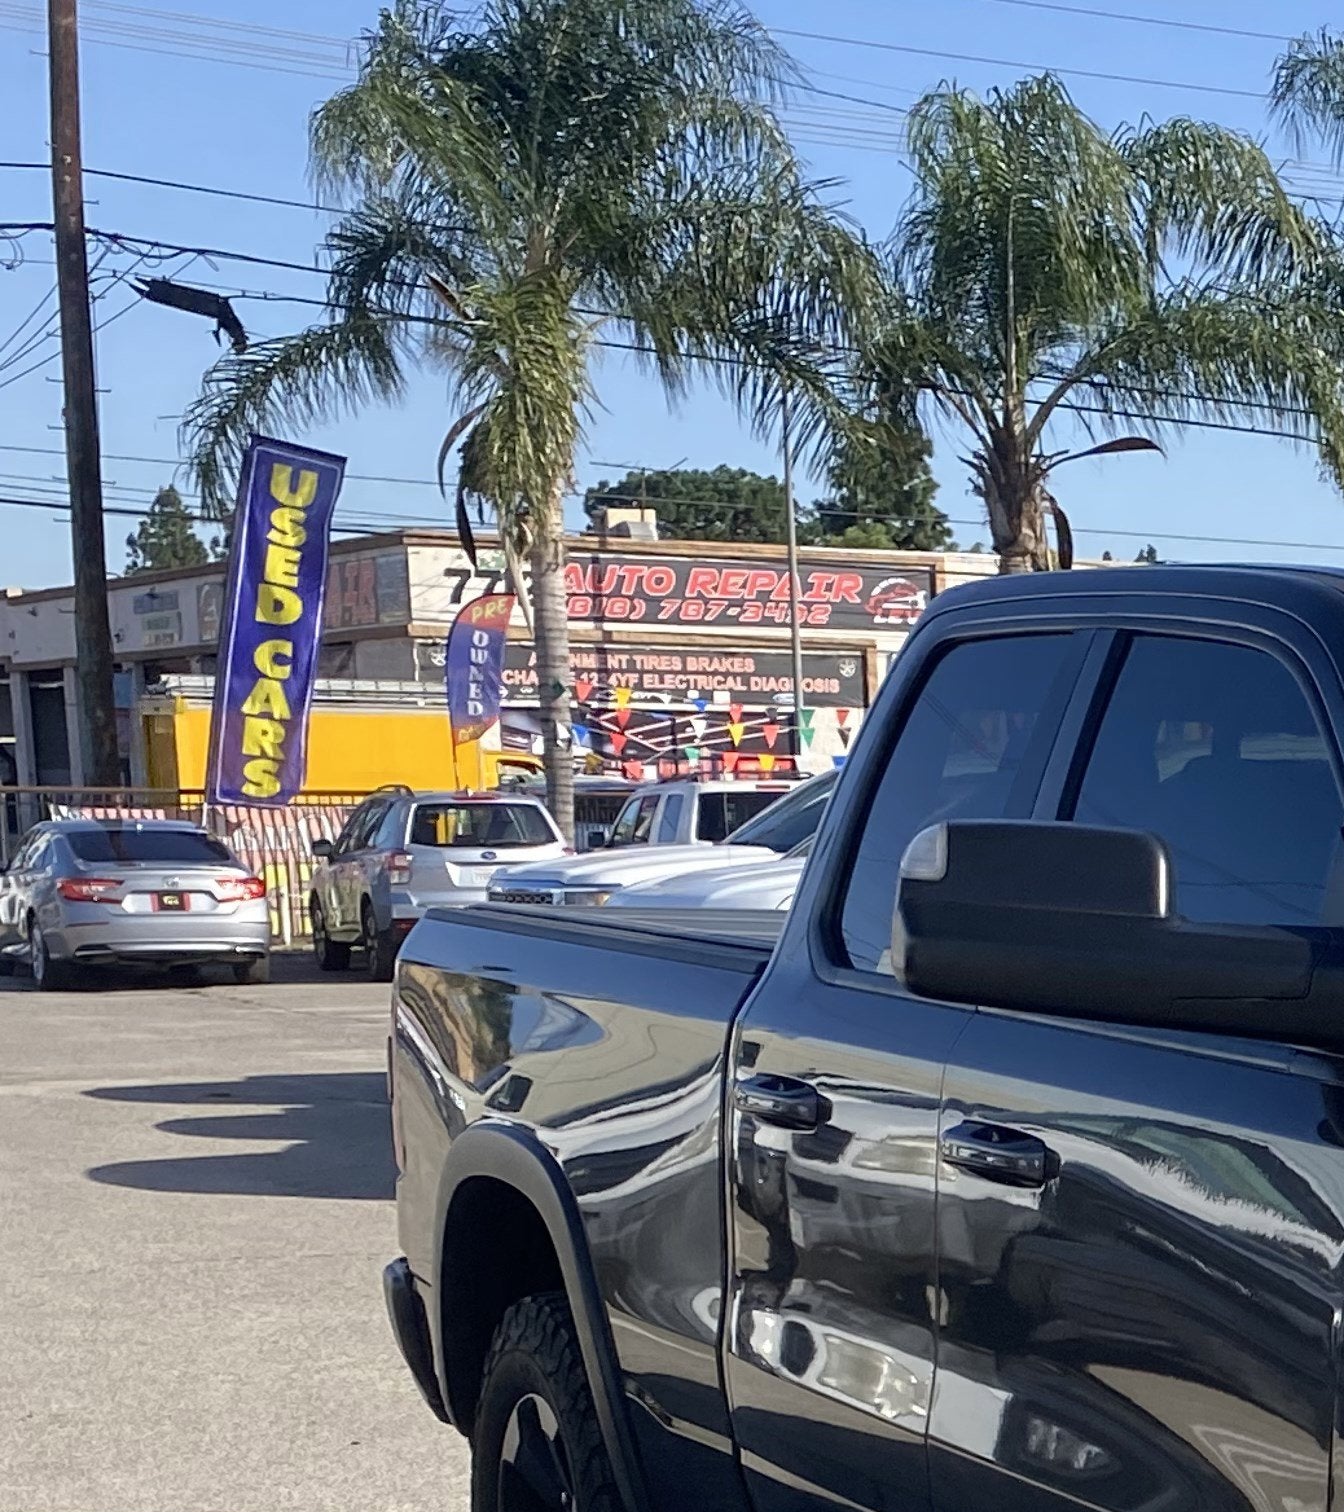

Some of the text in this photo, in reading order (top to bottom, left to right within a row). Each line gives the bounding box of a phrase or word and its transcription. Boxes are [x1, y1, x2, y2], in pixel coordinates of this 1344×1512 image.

[564, 562, 863, 604] AUTO REPAIR
[470, 597, 509, 625] PRE
[567, 595, 646, 621] 818)
[241, 463, 319, 798] USED CARS
[467, 629, 489, 717] OWNED
[633, 654, 682, 672] TIRES
[686, 656, 756, 674] BRAKES
[642, 672, 747, 692] ELECTRICAL
